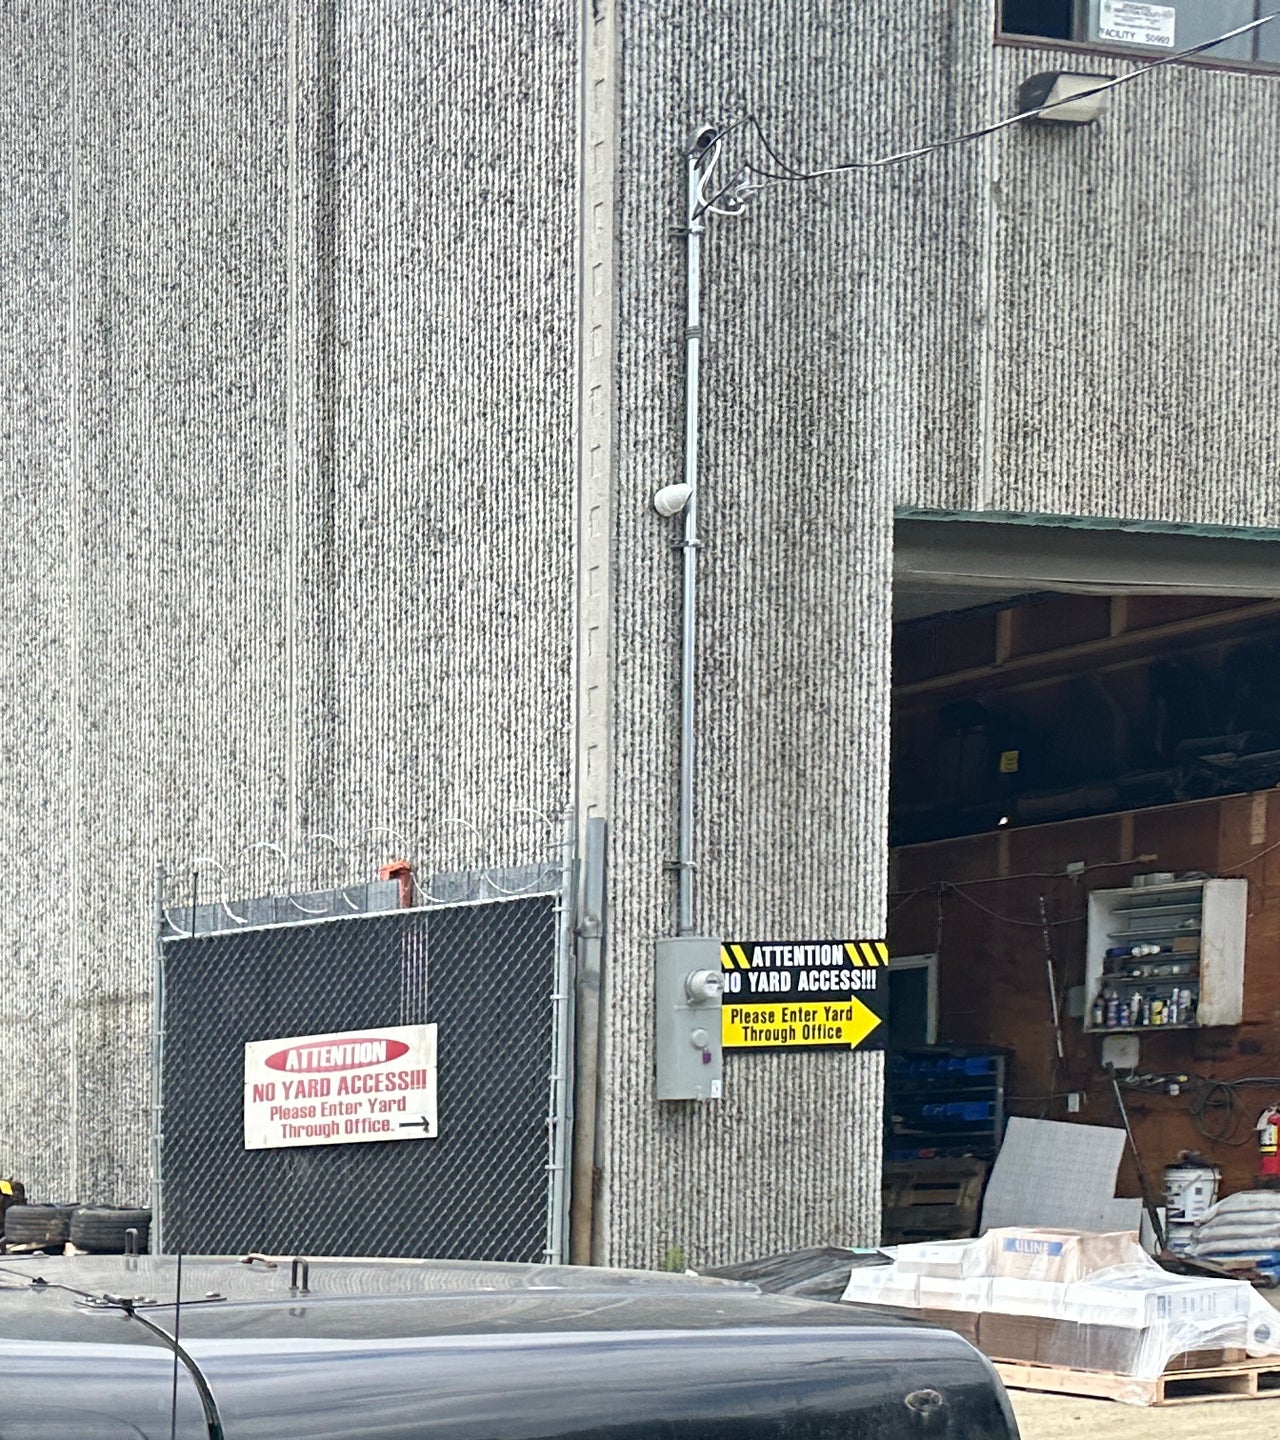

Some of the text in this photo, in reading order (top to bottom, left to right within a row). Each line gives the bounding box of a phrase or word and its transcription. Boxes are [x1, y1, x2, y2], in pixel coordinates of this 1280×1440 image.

[752, 945, 844, 968] ATTENTION
[748, 971, 791, 993] YARD
[797, 969, 877, 992] ACCESS!!!
[731, 1005, 853, 1025] Please Enter Yard
[742, 1023, 843, 1043] Through Office
[285, 1040, 387, 1071] ATTENTION
[253, 1069, 427, 1103] NO YARD ACCESS!!!
[270, 1096, 407, 1121] Please Enter Yard
[281, 1120, 340, 1139] Through
[1014, 1239, 1050, 1255] ULINE
